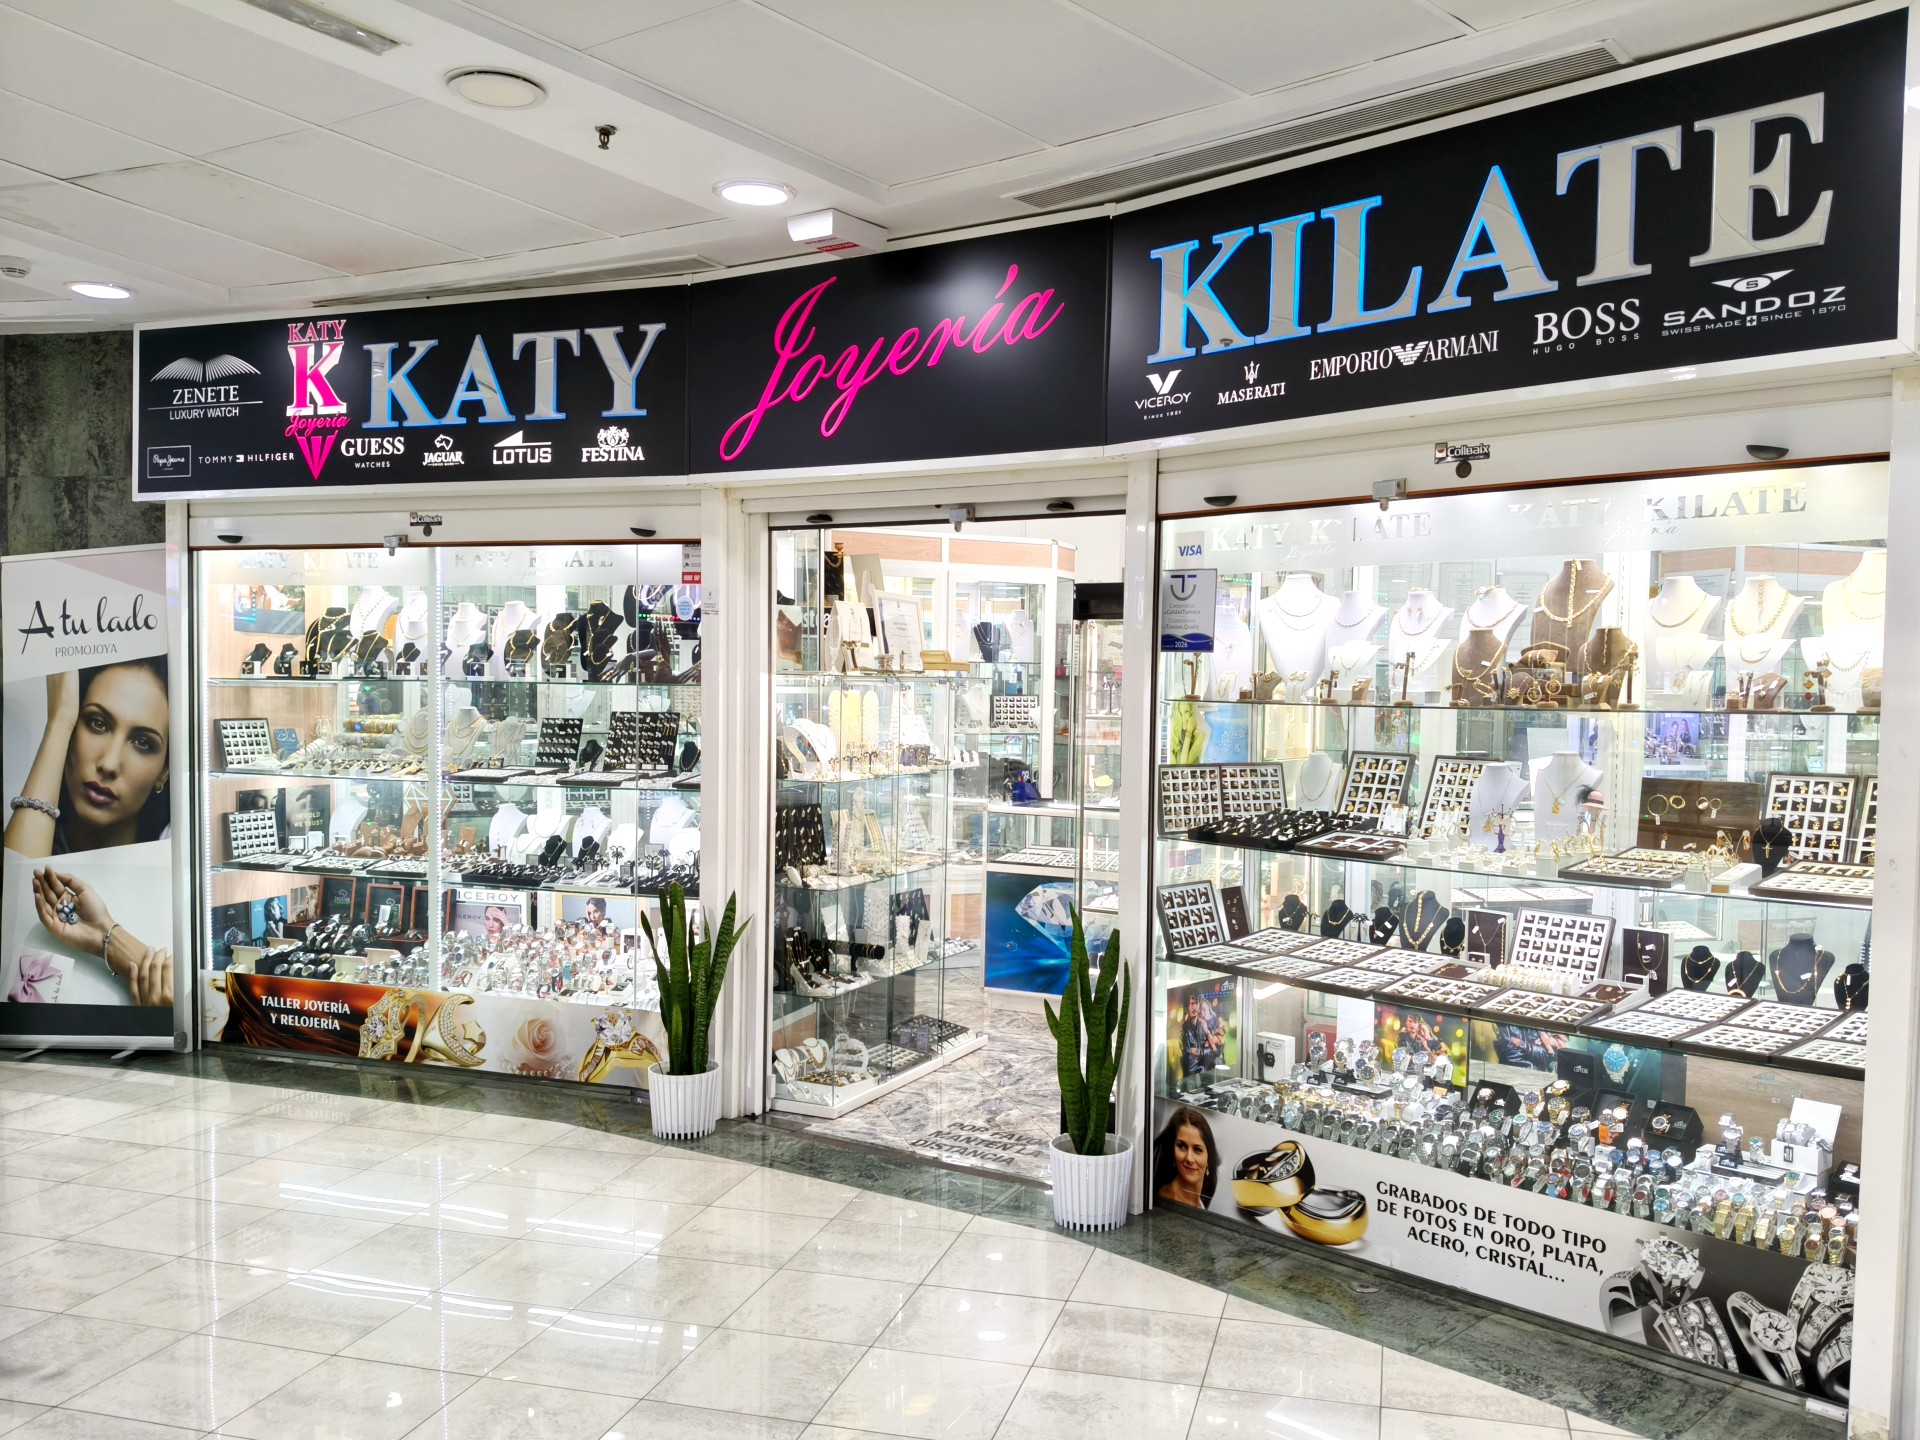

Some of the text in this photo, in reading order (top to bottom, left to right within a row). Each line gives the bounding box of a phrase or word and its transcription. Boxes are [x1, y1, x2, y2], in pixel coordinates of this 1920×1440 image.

[1147, 92, 1834, 366] KILATE
[1663, 286, 1846, 327] SANDOZ
[287, 319, 347, 343] KATY
[1533, 298, 1641, 345] BOSS
[1661, 304, 1846, 337] SWISS MADE SINCE 1870
[1309, 329, 1500, 381] EMPORIO ARMANI
[1532, 333, 1640, 355] HUGO BOSS
[719, 263, 1065, 461] Joyería
[361, 322, 666, 429] KATY
[172, 385, 240, 405] ZENETE
[1134, 391, 1192, 410] VICEROY
[1216, 382, 1286, 406] MASERATI
[169, 406, 240, 420] LUXURY WATCH
[284, 409, 350, 438] Joyería
[198, 452, 295, 464] TOMMY HILFIGER
[340, 436, 405, 457] GUESS
[492, 447, 552, 465] LOTUS
[581, 446, 645, 463] FESTINA
[354, 460, 391, 469] WATCHES
[422, 451, 465, 466] JAGUAR
[1639, 484, 1808, 524] KILATE
[1209, 522, 1293, 551] KATY
[1178, 544, 1202, 557] VISA
[18, 593, 158, 655] A tu lado
[55, 643, 118, 657] PROMOJOYA
[458, 891, 519, 902] ICEROY
[261, 994, 351, 1015] TALLER JOYERÍA
[269, 1012, 341, 1031] Y RELOJERÍA
[947, 1122, 989, 1133] POR
[910, 1139, 1015, 1165] DISTANCIA
[928, 1130, 1014, 1151] MANTEN
[1376, 1180, 1607, 1253] GRABADOS DE TODO TIPO
[1377, 1199, 1604, 1277] DE FOTOS EN ORO, PLATA,
[1407, 1226, 1566, 1283] ACERO, CRISTAL...
